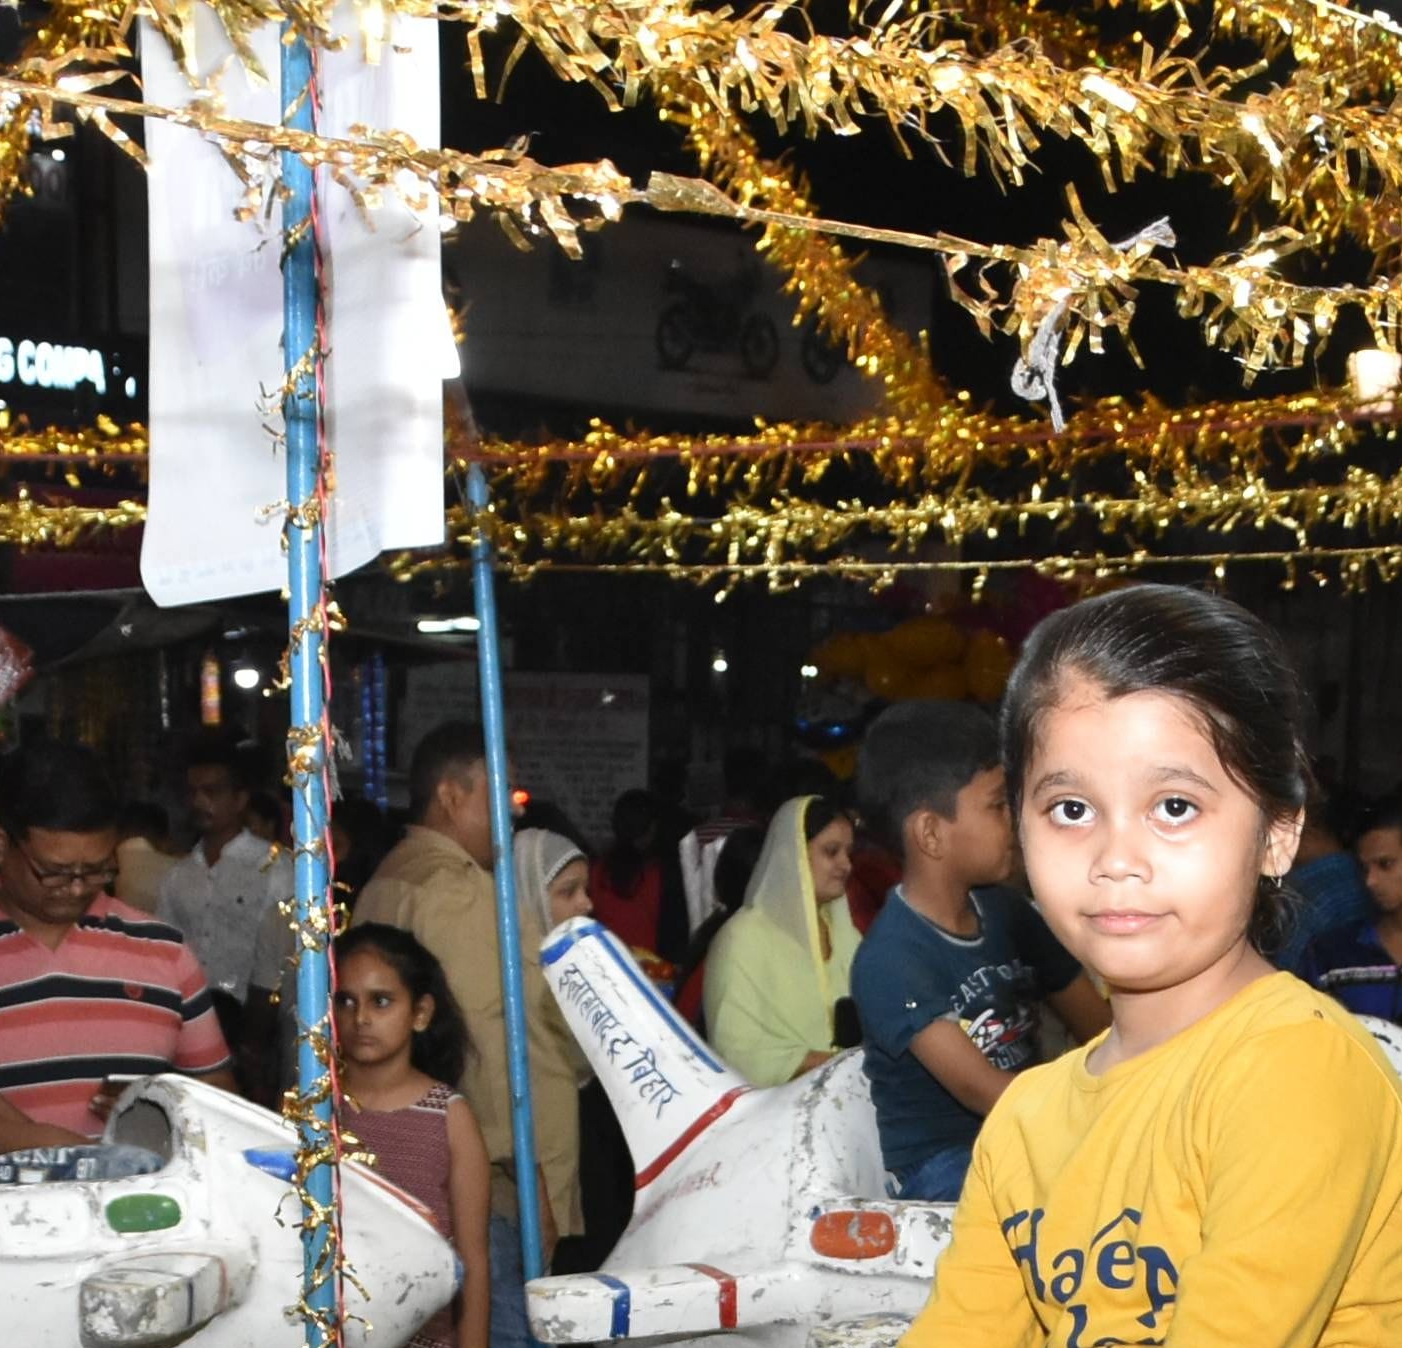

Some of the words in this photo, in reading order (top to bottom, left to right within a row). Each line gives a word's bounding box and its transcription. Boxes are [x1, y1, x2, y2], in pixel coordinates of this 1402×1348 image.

[18, 339, 135, 397] COMPA
[559, 962, 621, 1049] इलाहाबाद
[607, 1032, 640, 1064] टू
[622, 1048, 682, 1120] बिहार
